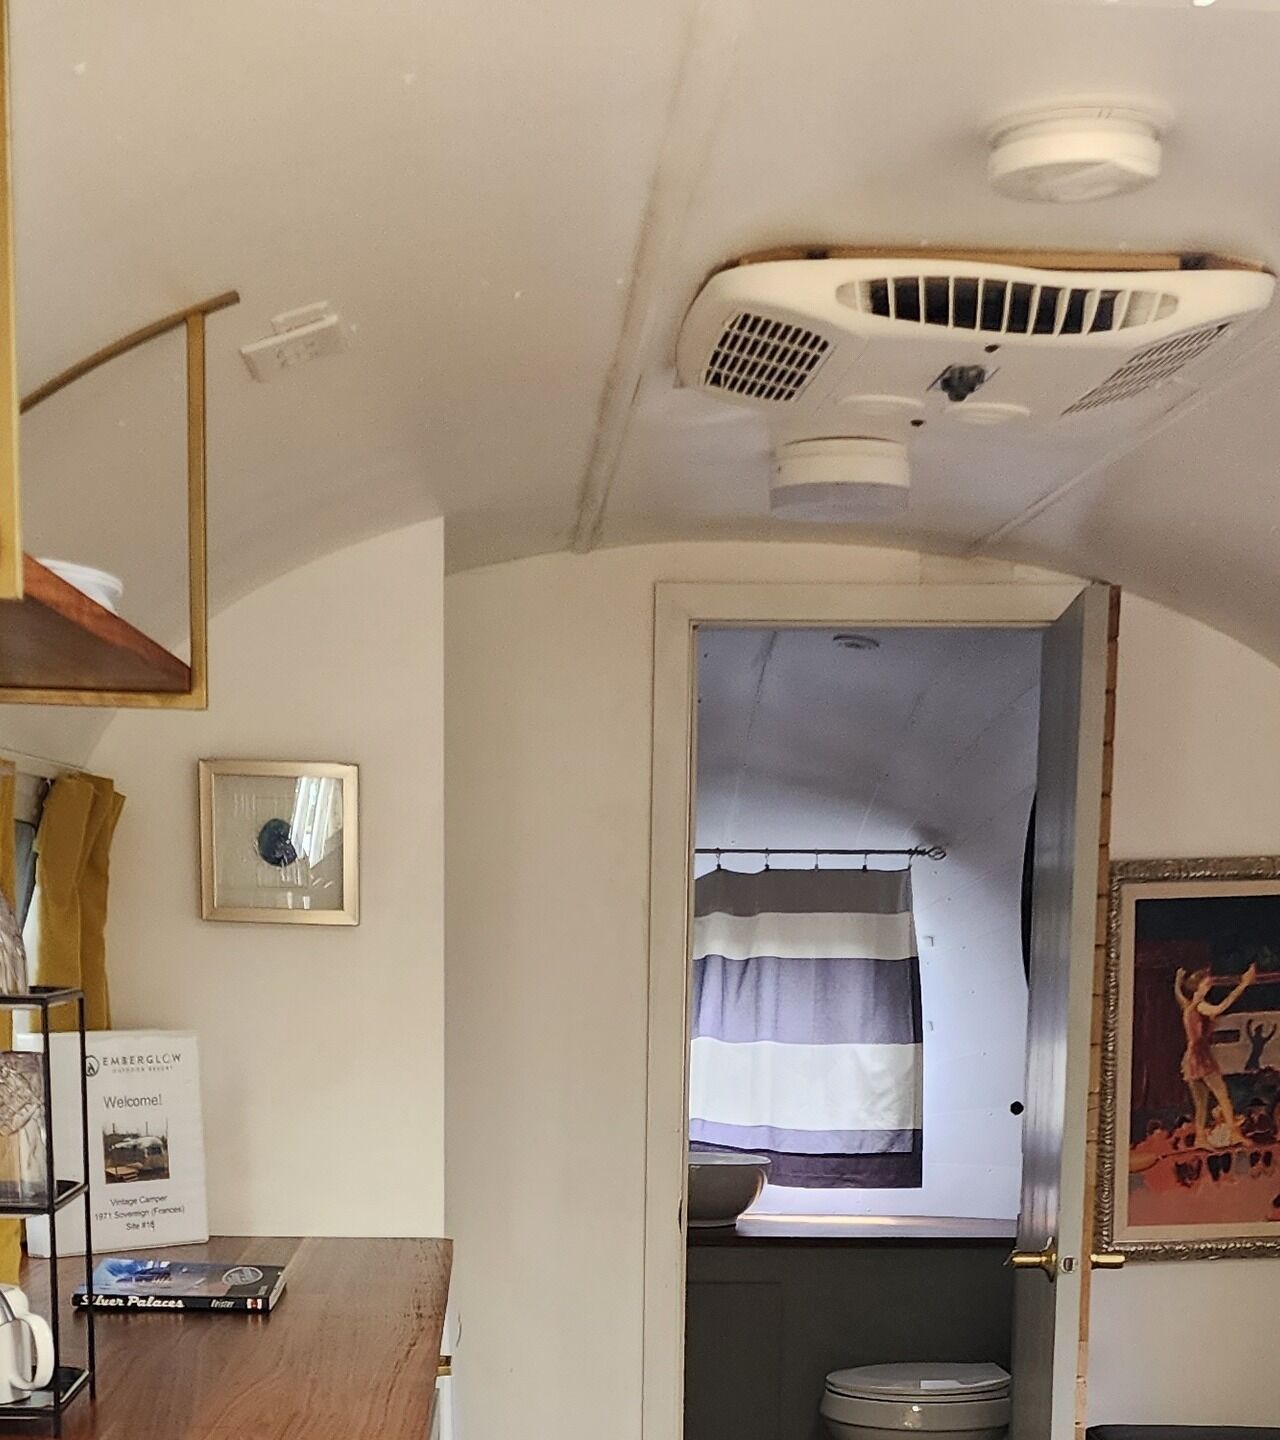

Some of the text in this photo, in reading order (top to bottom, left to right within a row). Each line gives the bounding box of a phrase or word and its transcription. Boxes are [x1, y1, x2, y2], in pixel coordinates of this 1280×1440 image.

[102, 1053, 181, 1066] EMBERGLOW
[103, 1093, 162, 1108] Welcome!
[80, 1294, 185, 1308] Slver Palaces
